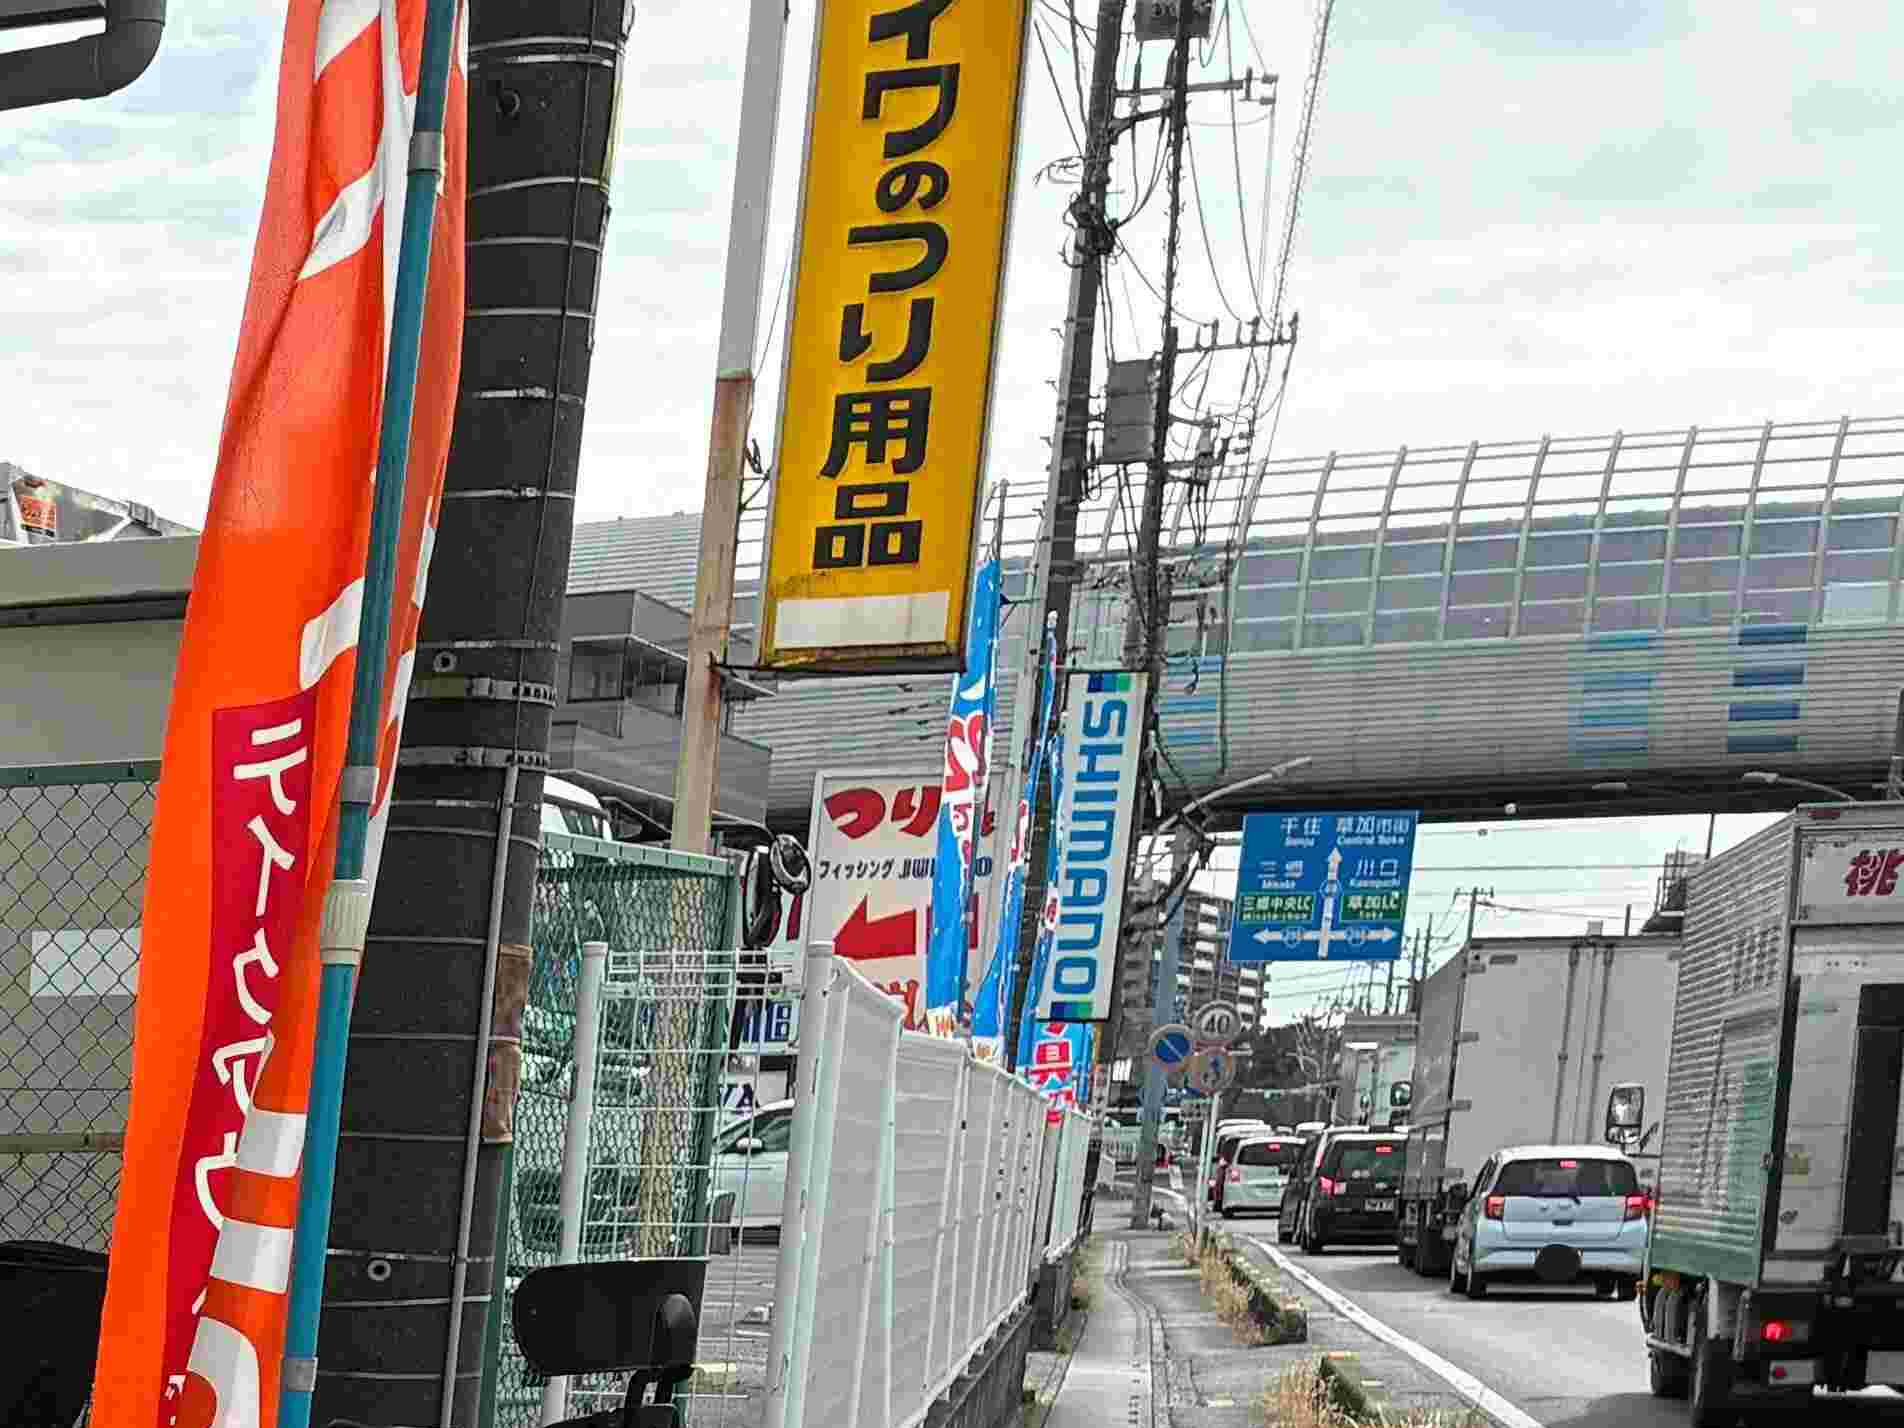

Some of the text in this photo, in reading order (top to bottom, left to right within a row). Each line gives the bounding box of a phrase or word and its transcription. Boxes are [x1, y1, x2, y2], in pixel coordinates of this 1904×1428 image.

[824, 786, 994, 839] つり
[1053, 700, 1129, 995] SHIMANO
[819, 857, 895, 880] フィッシング
[1355, 857, 1399, 877] 川口
[1204, 1015, 1230, 1034] 40
